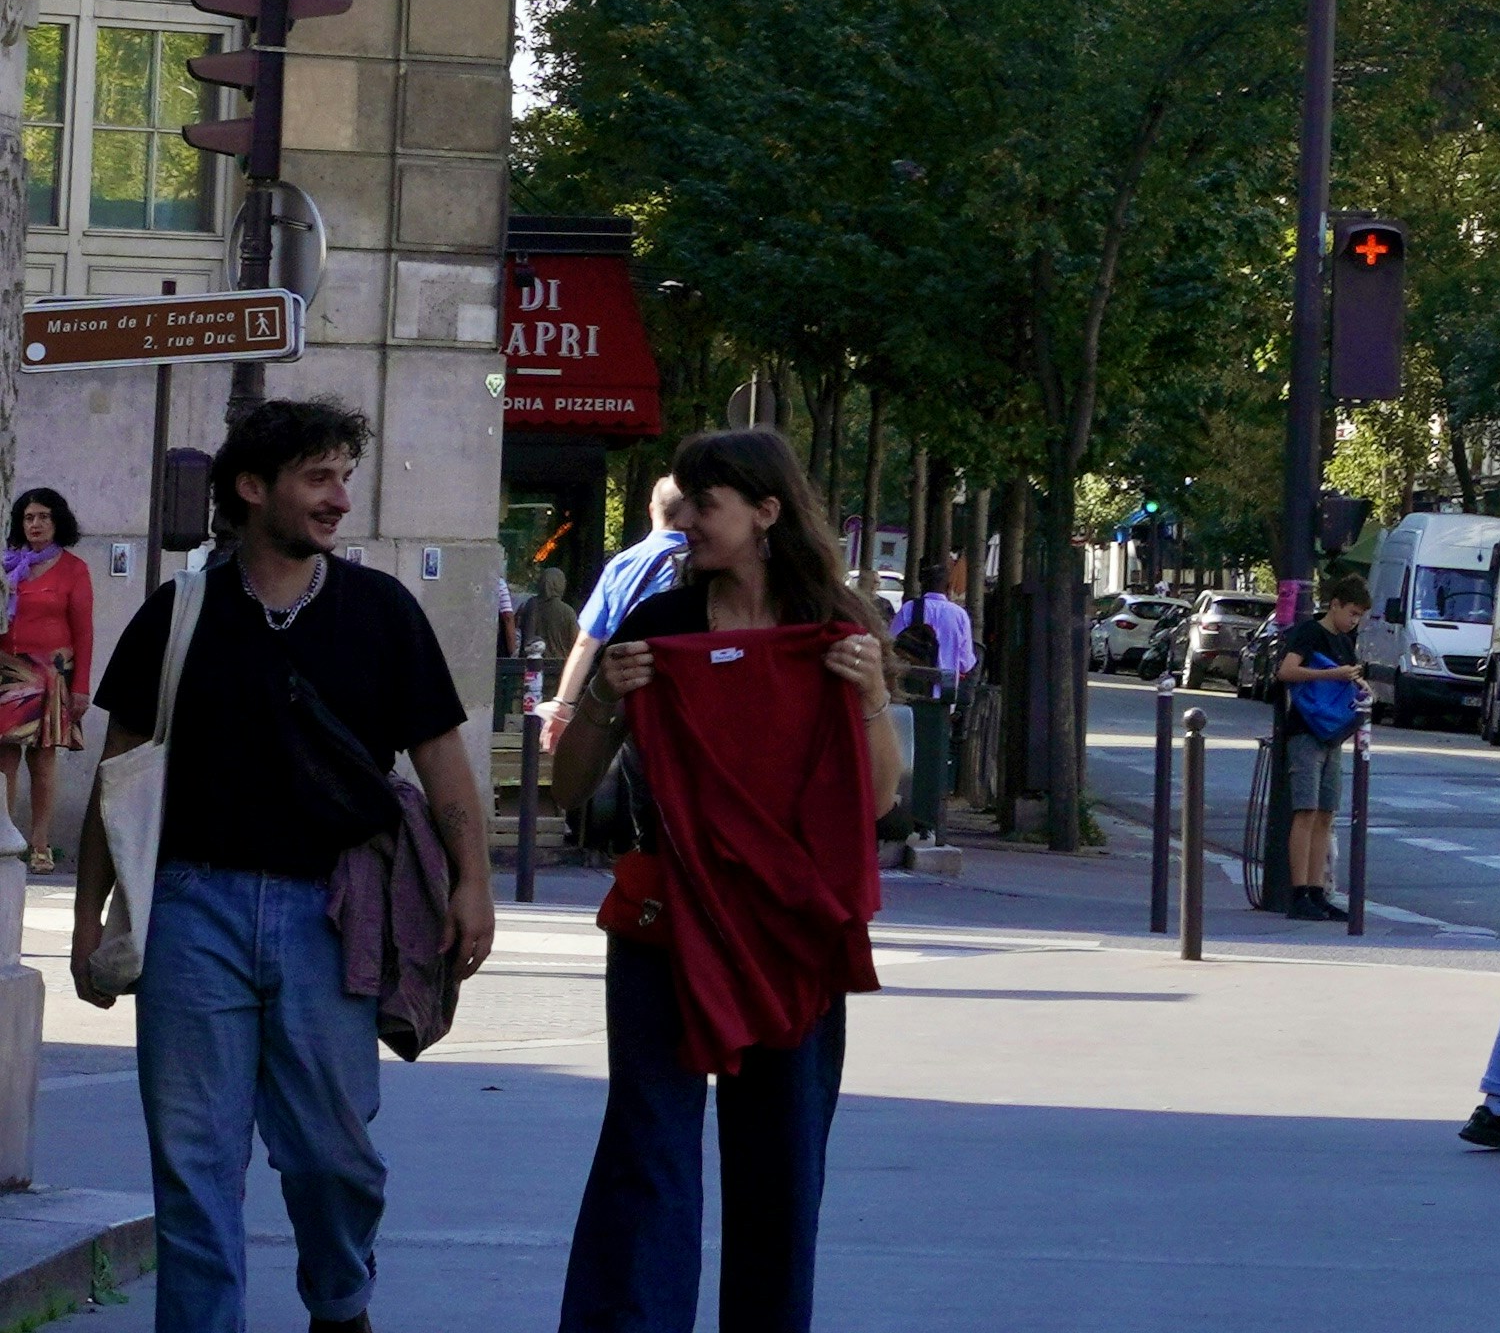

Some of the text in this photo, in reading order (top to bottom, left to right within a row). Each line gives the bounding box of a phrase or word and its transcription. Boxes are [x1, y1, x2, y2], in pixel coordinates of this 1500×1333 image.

[518, 277, 562, 311] DI
[47, 319, 108, 333] Maison
[117, 315, 137, 329] de
[167, 310, 236, 326] Enfance
[167, 335, 194, 348] rue
[203, 331, 237, 346] Duc
[499, 321, 600, 359] APRI
[502, 397, 635, 412] ORIA PIZZERIA
